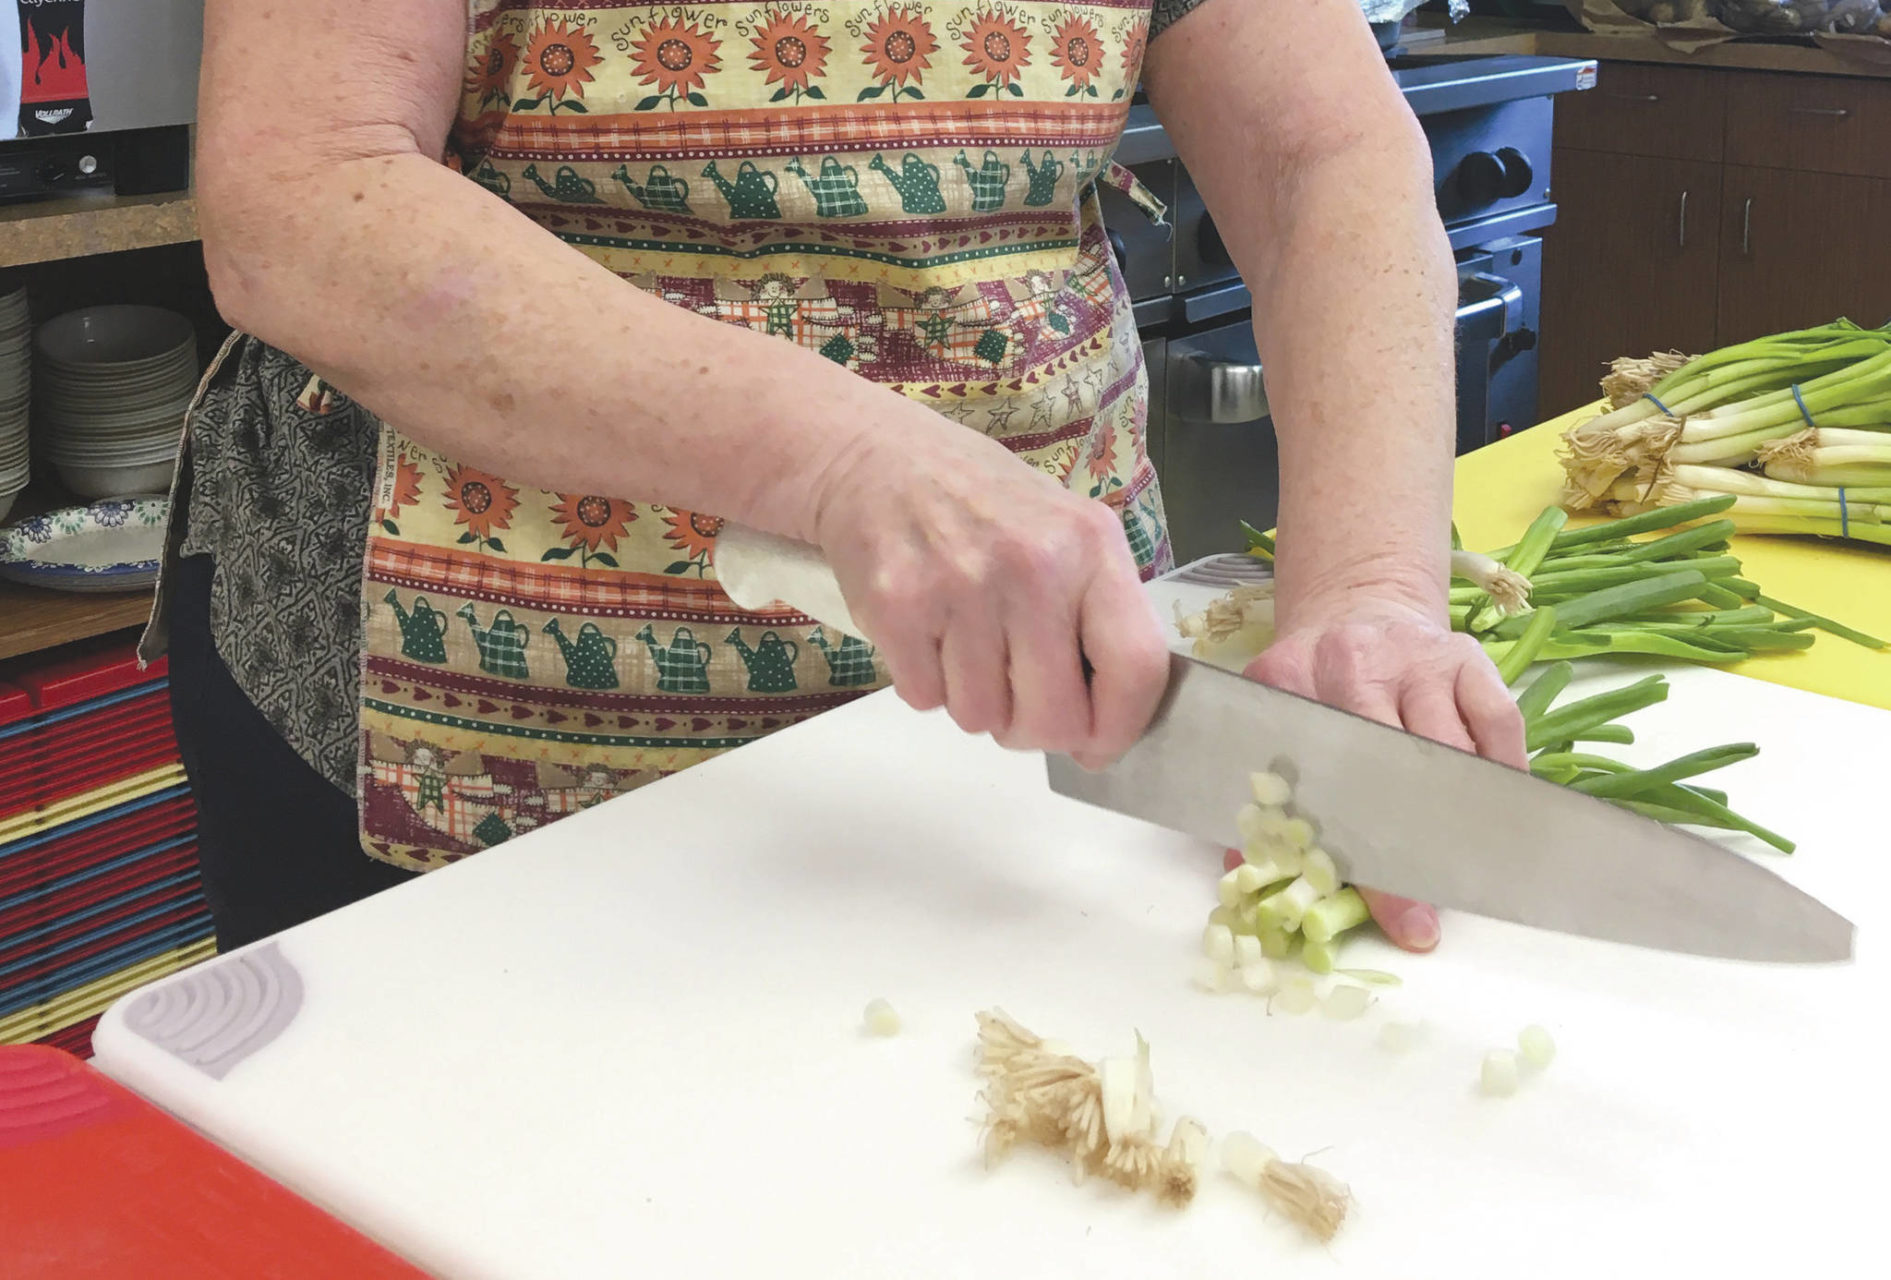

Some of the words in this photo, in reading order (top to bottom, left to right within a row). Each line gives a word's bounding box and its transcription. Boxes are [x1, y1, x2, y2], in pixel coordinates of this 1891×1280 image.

[611, 5, 728, 52] Sunflower
[735, 0, 830, 37] Sunflowers
[845, 0, 933, 38] Sunflower
[945, 0, 1037, 41] Sunflower
[1041, 2, 1105, 34] Sunflowers
